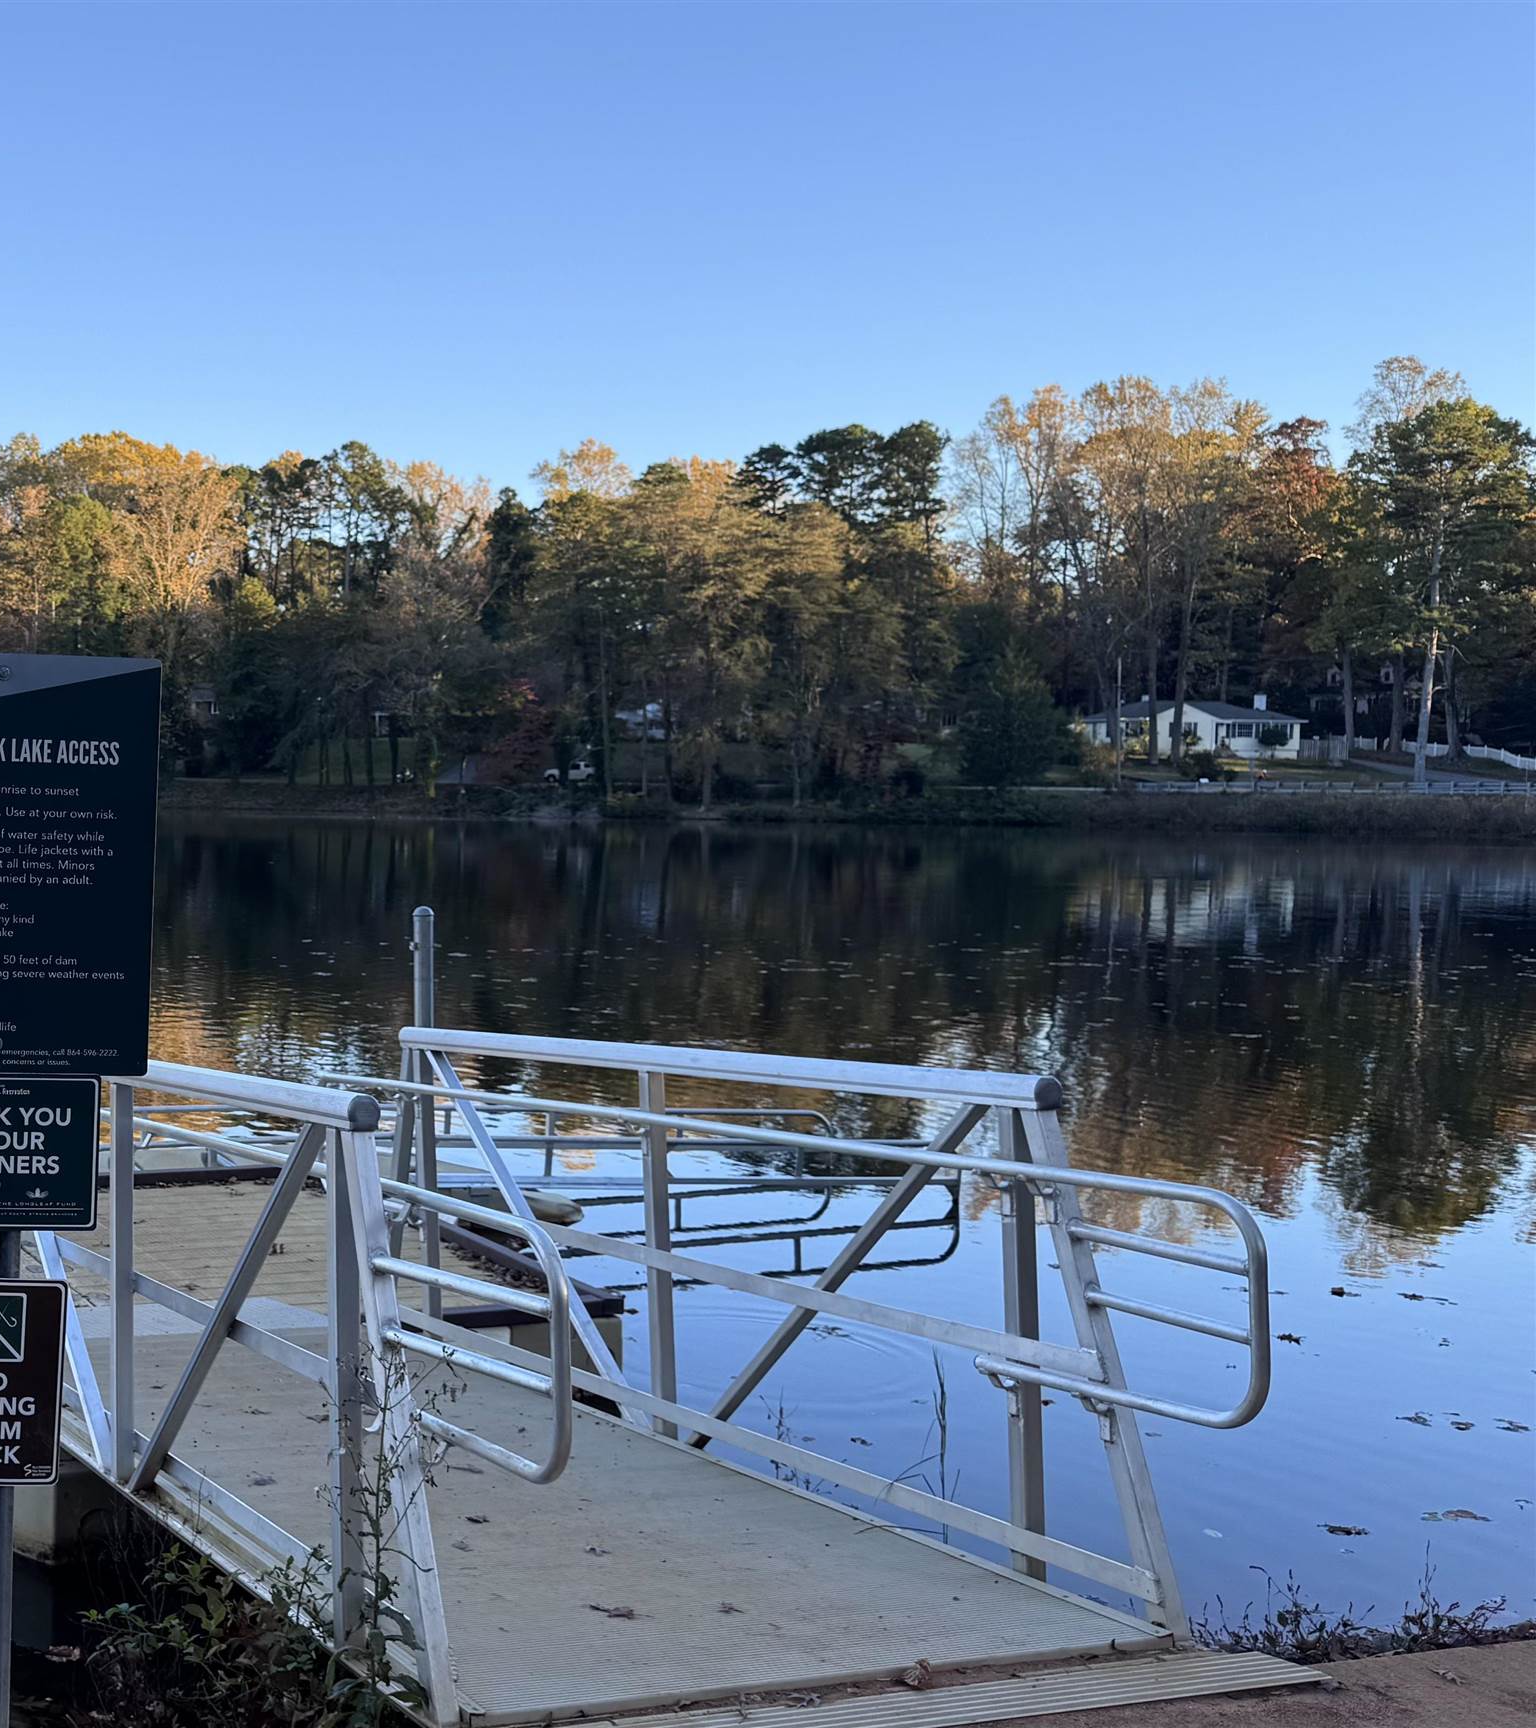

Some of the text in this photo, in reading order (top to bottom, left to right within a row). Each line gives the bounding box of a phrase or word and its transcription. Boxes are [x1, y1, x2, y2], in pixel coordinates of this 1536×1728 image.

[11, 738, 52, 762] LAKE
[56, 740, 119, 765] ACCESS
[6, 806, 25, 816] Use
[29, 809, 39, 817] at
[43, 810, 66, 820] your
[96, 809, 116, 819] risk.
[7, 831, 37, 840] water
[41, 830, 73, 843] safety
[76, 832, 104, 841] while
[18, 844, 37, 854] Life
[40, 846, 77, 857] jackets
[81, 846, 103, 856] with
[6, 858, 17, 868] all
[22, 859, 53, 869] times.
[58, 859, 94, 870] Minors
[30, 873, 42, 886] by
[62, 874, 92, 884] adult.
[13, 914, 34, 923] kind
[3, 954, 15, 963] 50
[19, 954, 38, 964] feet
[41, 955, 52, 964] of
[55, 955, 76, 964] dam
[48, 969, 88, 978] weather
[92, 971, 124, 979] events
[19, 1107, 70, 1126] YOU
